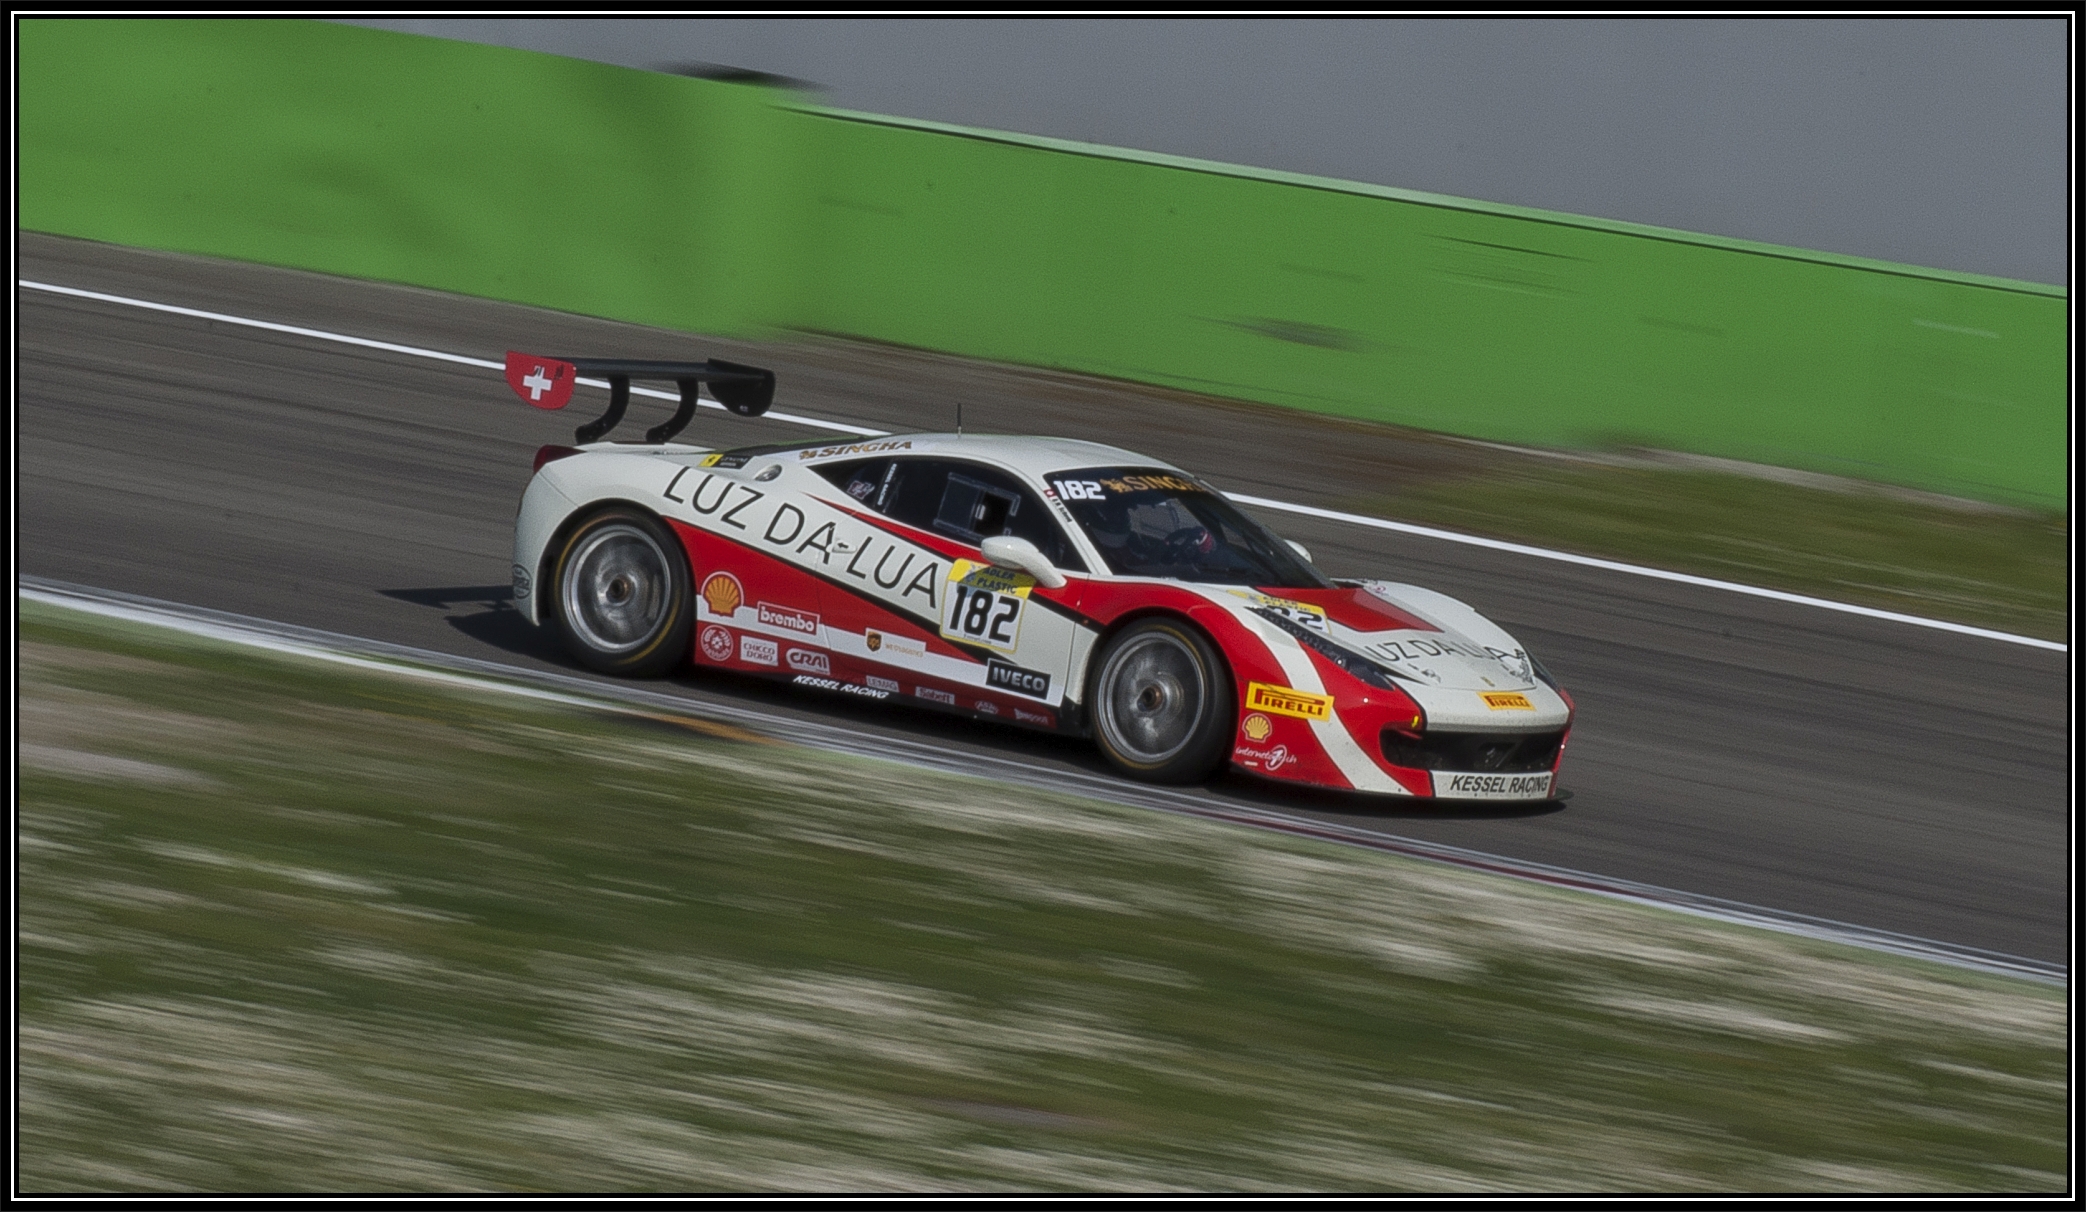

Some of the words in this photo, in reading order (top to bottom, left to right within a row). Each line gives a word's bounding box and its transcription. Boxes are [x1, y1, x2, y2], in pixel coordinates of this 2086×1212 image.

[819, 441, 912, 457] SINGHA
[1053, 480, 1106, 500] 182
[663, 465, 764, 530] LUZ
[764, 502, 836, 565] DA
[846, 536, 939, 609] LUA
[983, 567, 1015, 581] ADLER
[976, 577, 1018, 594] PLASTIC
[760, 606, 815, 632] brembo
[949, 585, 1020, 643] 182
[790, 652, 827, 669] CRAI
[793, 675, 840, 690] KESSEL
[840, 684, 889, 699] RACING
[992, 667, 1046, 691] IVECO
[1254, 689, 1325, 716] PIRELLI
[1484, 695, 1531, 708] PIRELLI
[1450, 775, 1506, 792] KESSEL
[1509, 775, 1550, 793] RACING
